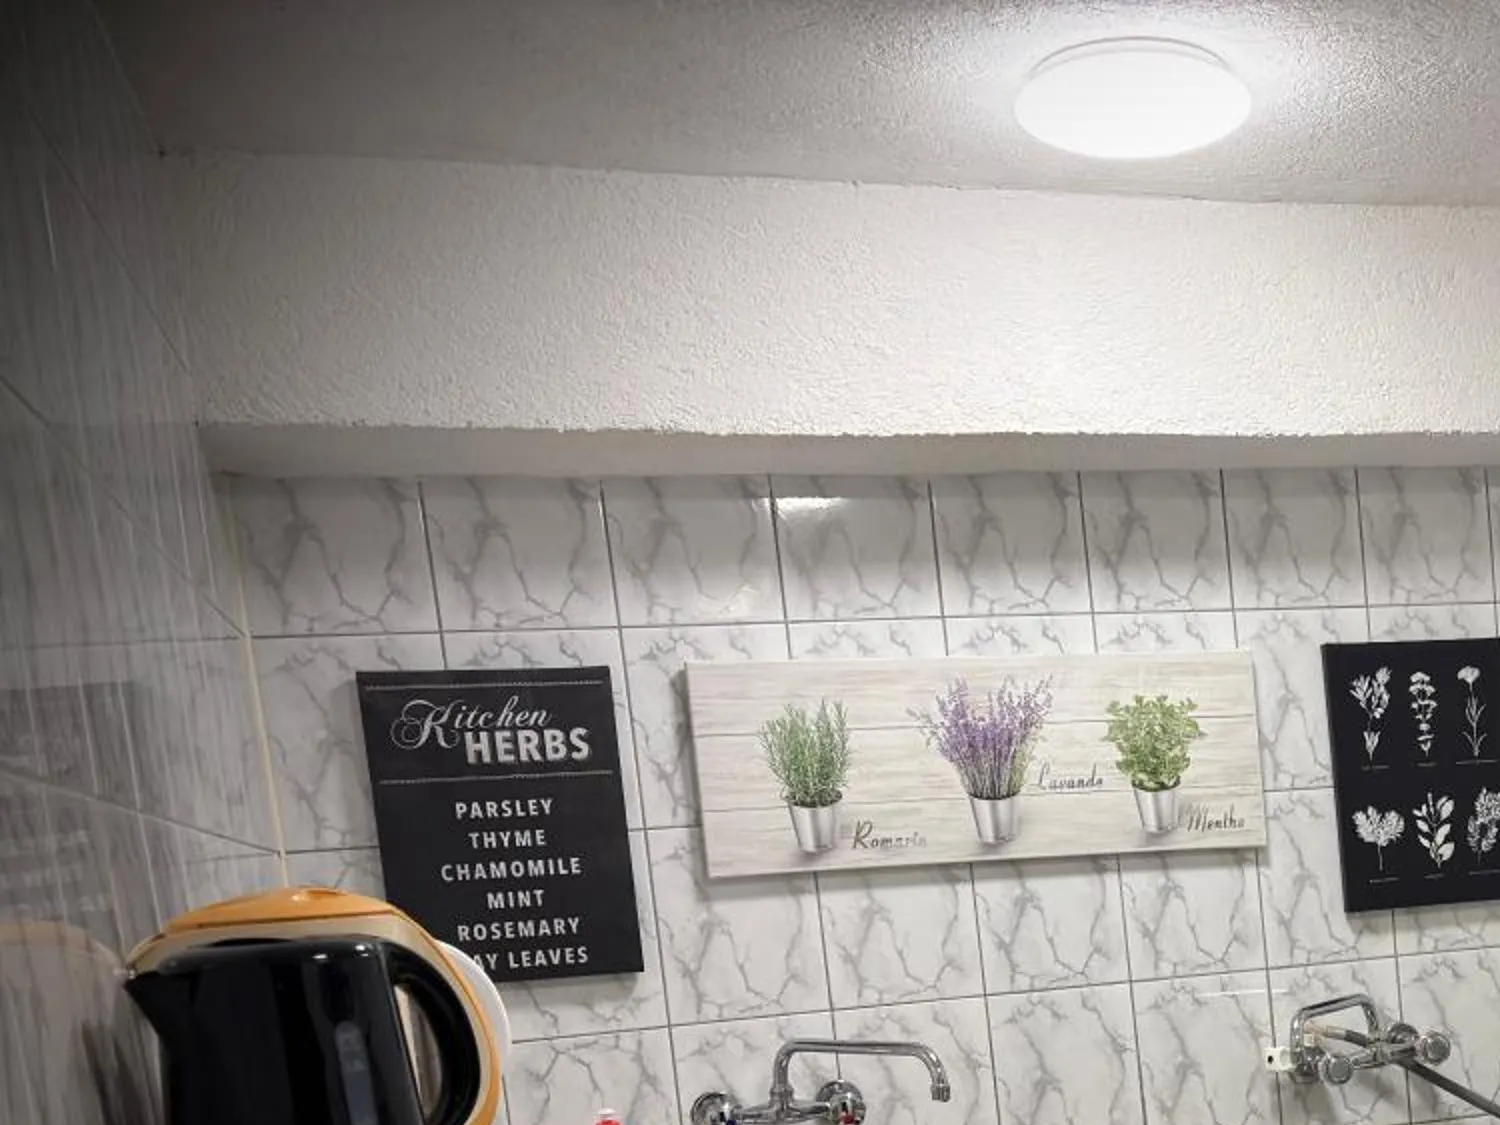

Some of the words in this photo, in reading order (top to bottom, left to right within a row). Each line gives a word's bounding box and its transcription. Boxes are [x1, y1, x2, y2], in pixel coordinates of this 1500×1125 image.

[390, 695, 551, 750] Kitchen
[464, 726, 590, 764] HERBS
[455, 797, 553, 820] PARSLEY
[468, 828, 547, 849] THYME
[440, 857, 582, 882] CHAMOMILE
[487, 889, 545, 909] MINT
[457, 916, 580, 942] ROSEMARY
[472, 952, 498, 971] AY
[508, 946, 589, 969] LEAVES
